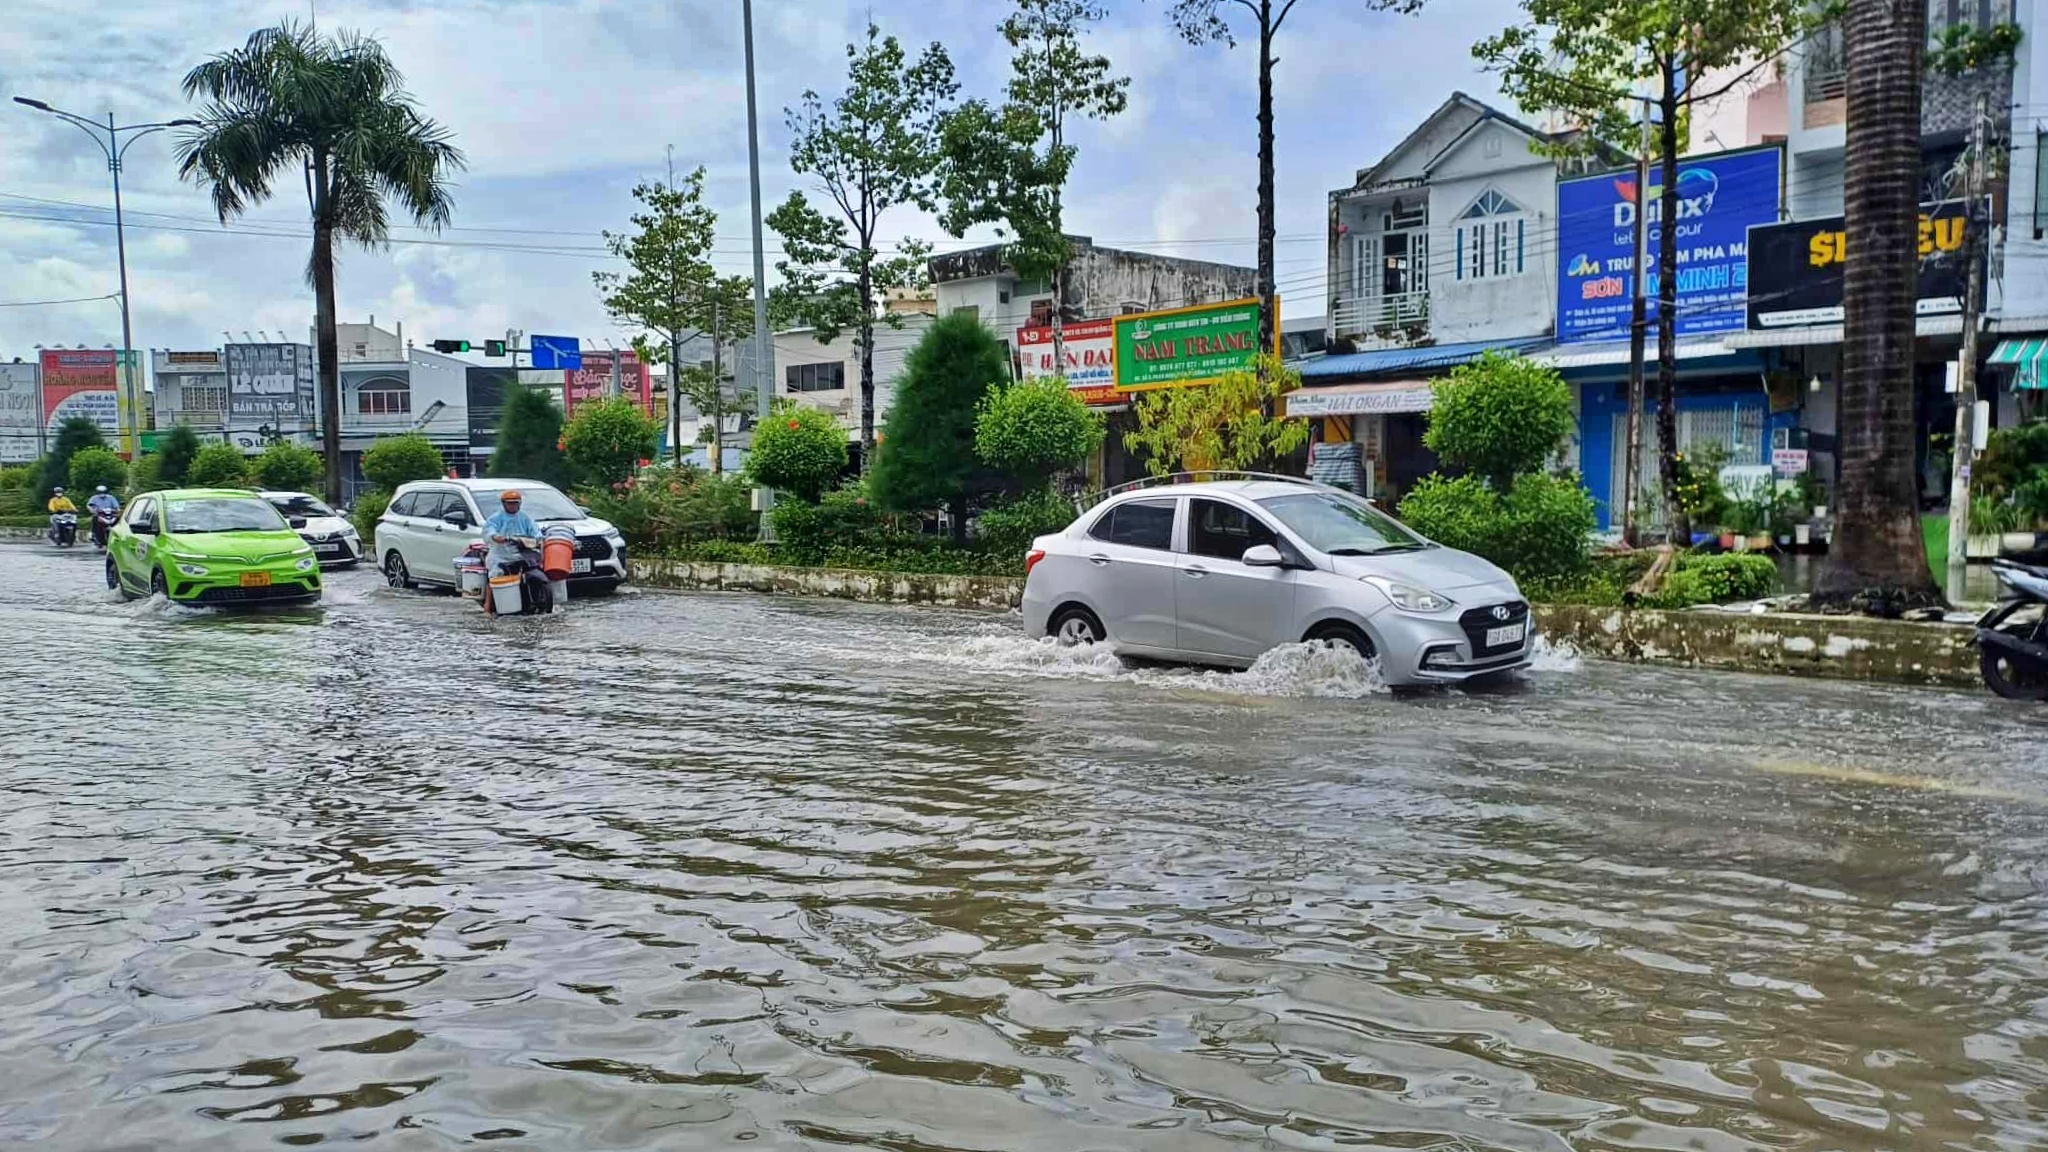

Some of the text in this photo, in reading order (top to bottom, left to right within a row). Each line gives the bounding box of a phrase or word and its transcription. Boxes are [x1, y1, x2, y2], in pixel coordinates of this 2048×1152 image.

[1693, 247, 1725, 261] PHA
[1582, 276, 1623, 299] SƠN
[1676, 265, 1729, 293] MINH
[1134, 330, 1255, 361] NAM TRANG
[232, 400, 253, 412] BÁN
